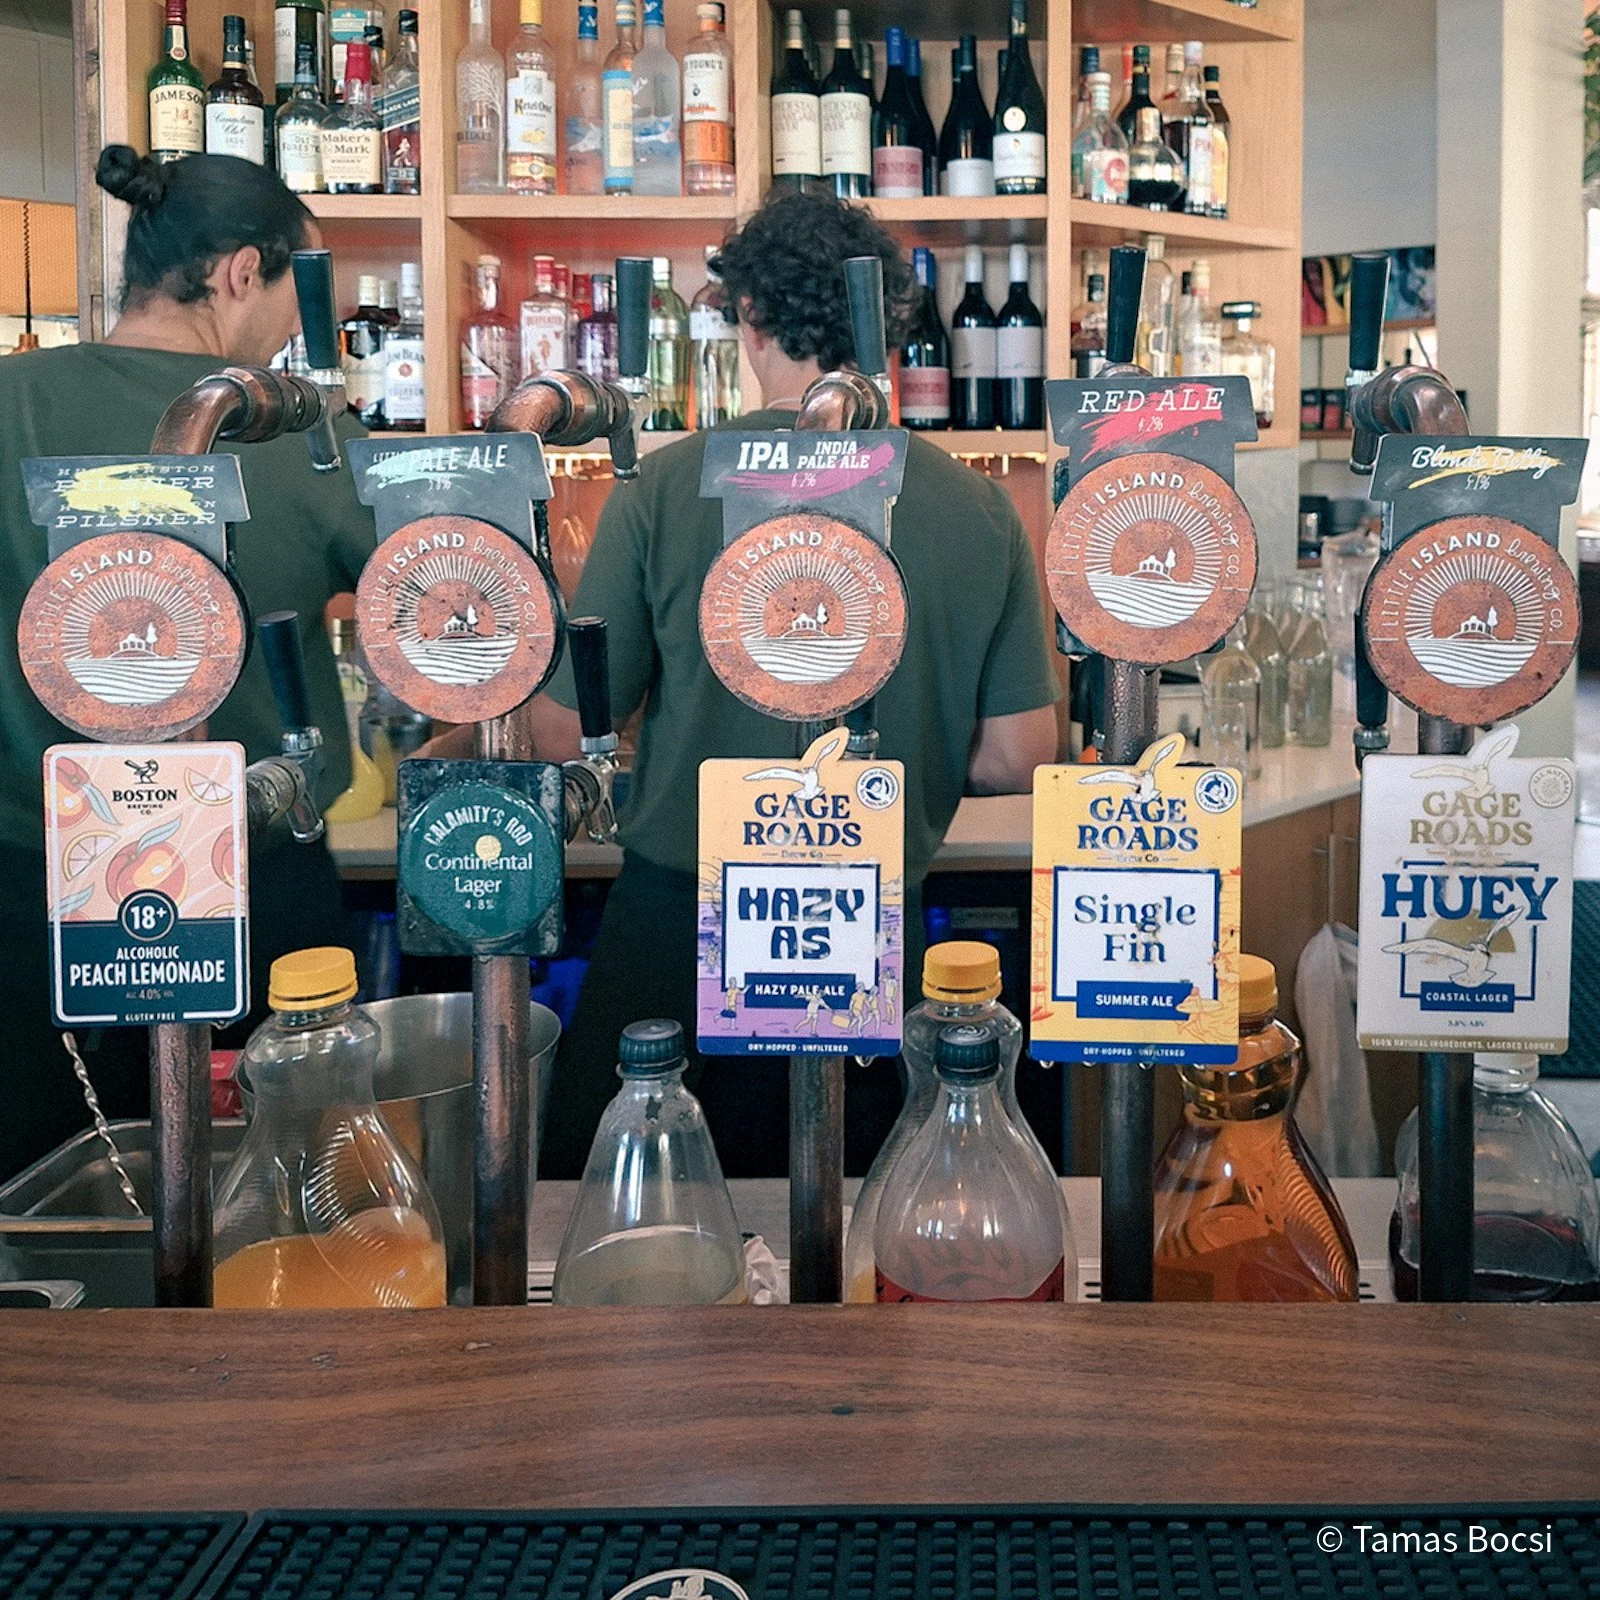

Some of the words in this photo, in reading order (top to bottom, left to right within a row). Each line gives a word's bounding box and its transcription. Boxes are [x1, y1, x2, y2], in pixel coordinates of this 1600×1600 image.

[321, 133, 371, 144] Maker's
[333, 144, 371, 154] Mark
[1077, 389, 1145, 413] RED
[1156, 387, 1226, 412] ALE
[467, 443, 508, 470] ALE
[736, 441, 790, 470] IPA
[814, 440, 858, 455] INDIA
[795, 455, 837, 470] PALE
[839, 454, 872, 469] ALE
[54, 512, 217, 529] PILSNER
[1062, 503, 1097, 560] LITTLE
[1093, 471, 1185, 505] ISLAND
[1187, 480, 1241, 548] brewing
[369, 575, 393, 633] LITTLE
[386, 532, 465, 575] ISLAND
[471, 535, 532, 595] brewing
[713, 568, 744, 628] LITTLE
[737, 530, 823, 571] ISLAND
[828, 535, 887, 596] brewing
[1381, 568, 1415, 627] LITTLE
[1410, 531, 1501, 570] ISLAND
[1503, 538, 1562, 602] brewing
[35, 590, 66, 650] LITTLE
[60, 548, 154, 590] ISLAND
[160, 554, 222, 616] brewing
[112, 789, 178, 802] BOSTON
[754, 793, 851, 820] GAGE
[1422, 790, 1522, 819] GAGE
[1089, 796, 1188, 823] GAGE
[423, 804, 505, 846] CALAMITY'S
[503, 816, 534, 847] ROD
[742, 821, 862, 847] ROADS
[1077, 825, 1199, 852] ROADS
[1409, 819, 1534, 846] ROADS
[424, 851, 534, 871] Continental
[1145, 853, 1160, 863] Co
[454, 877, 503, 898] Lager
[1381, 873, 1560, 921] HUEY
[738, 887, 865, 922] HAZY
[1073, 893, 1198, 934] Single
[130, 905, 167, 931] 18+
[115, 945, 180, 961] ALCOHOLIC
[770, 926, 831, 960] AS
[1103, 933, 1167, 963] Fin
[69, 962, 127, 987] PEACH
[131, 959, 226, 985] LEMONADE
[138, 989, 162, 1000] 4.0%
[755, 984, 788, 996] HAZY
[789, 984, 820, 996] PALE
[822, 985, 846, 996] ALE
[1095, 993, 1149, 1007] SUMMER
[1151, 995, 1174, 1007] ALE
[1425, 991, 1472, 1003] COASTAL
[1474, 992, 1509, 1003] LAGER
[124, 1012, 155, 1022] GLUTEN
[156, 1011, 176, 1021] FREE
[802, 1044, 849, 1053] UNFILTERED
[1393, 1038, 1429, 1048] NATURAL
